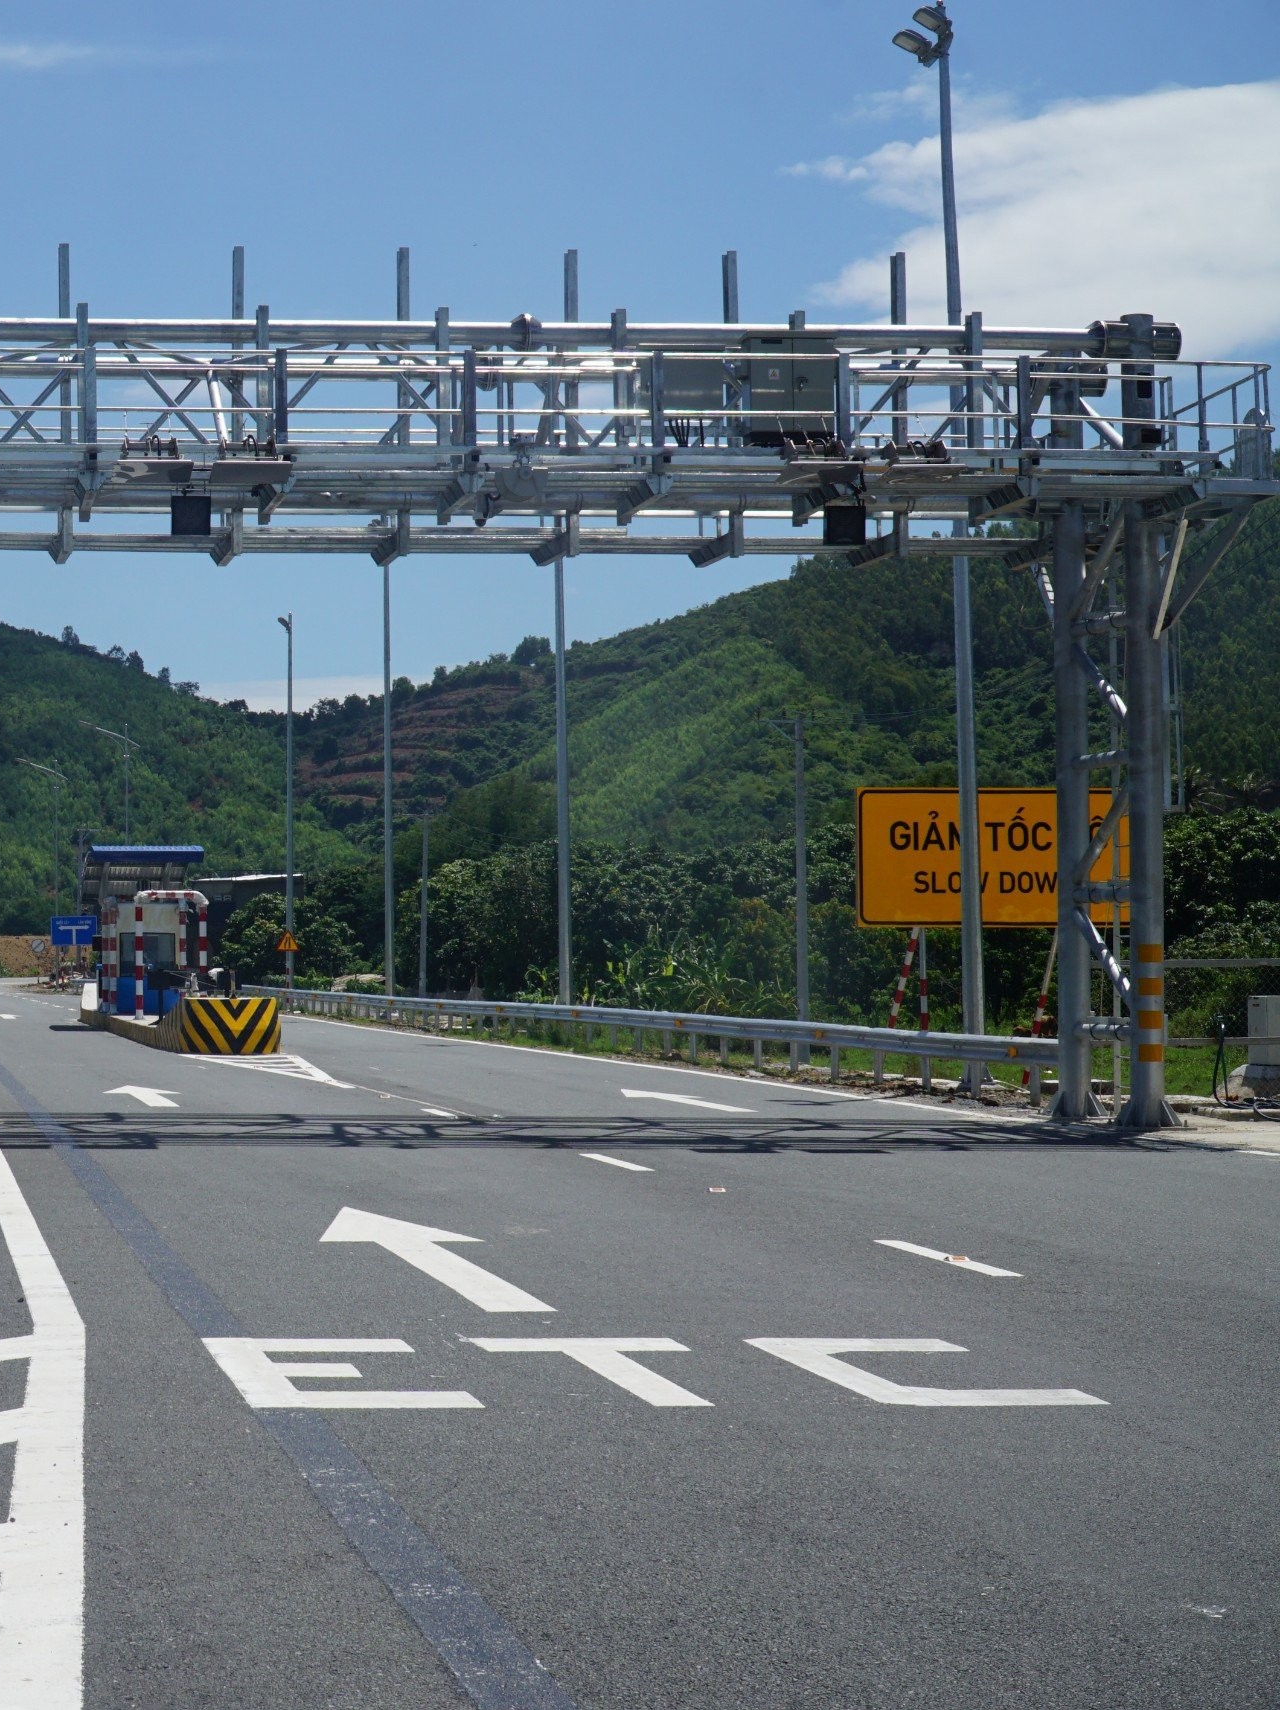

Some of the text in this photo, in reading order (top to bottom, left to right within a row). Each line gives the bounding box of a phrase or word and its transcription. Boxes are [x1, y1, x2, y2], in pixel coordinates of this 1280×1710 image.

[984, 806, 1053, 852] TỐC
[999, 871, 1058, 894] DOW
[201, 1337, 1111, 1408] ETC
